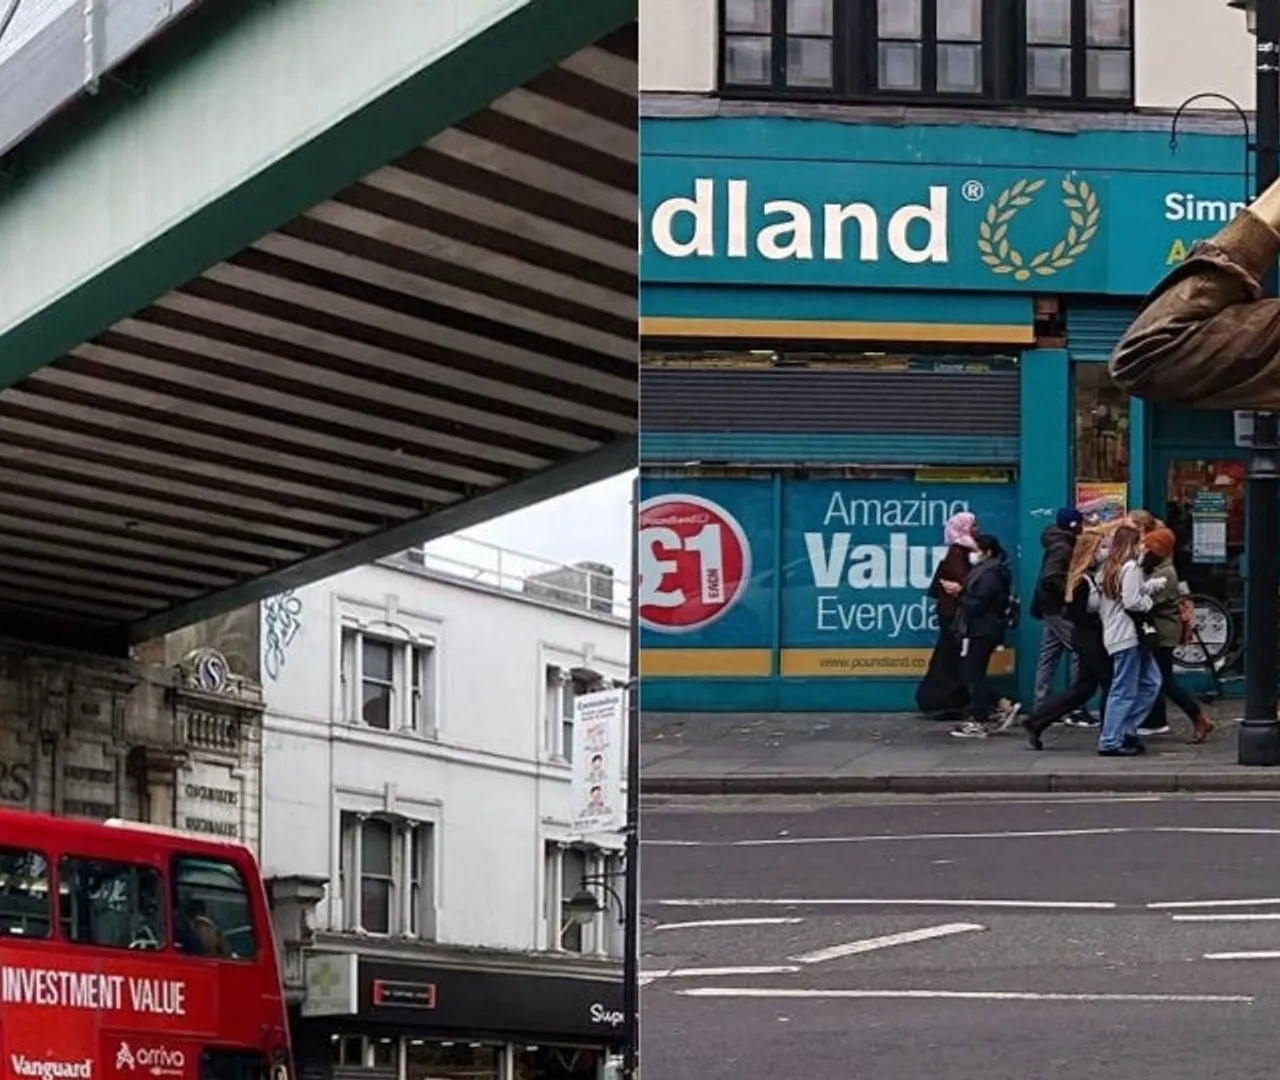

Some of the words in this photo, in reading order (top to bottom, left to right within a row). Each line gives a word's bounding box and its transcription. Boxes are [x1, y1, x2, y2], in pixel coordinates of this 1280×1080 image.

[639, 178, 949, 263] dland
[638, 524, 725, 607] £1
[804, 532, 948, 590] Valu
[2, 965, 124, 1010] INVESTMENT
[128, 977, 186, 1015] VALUE
